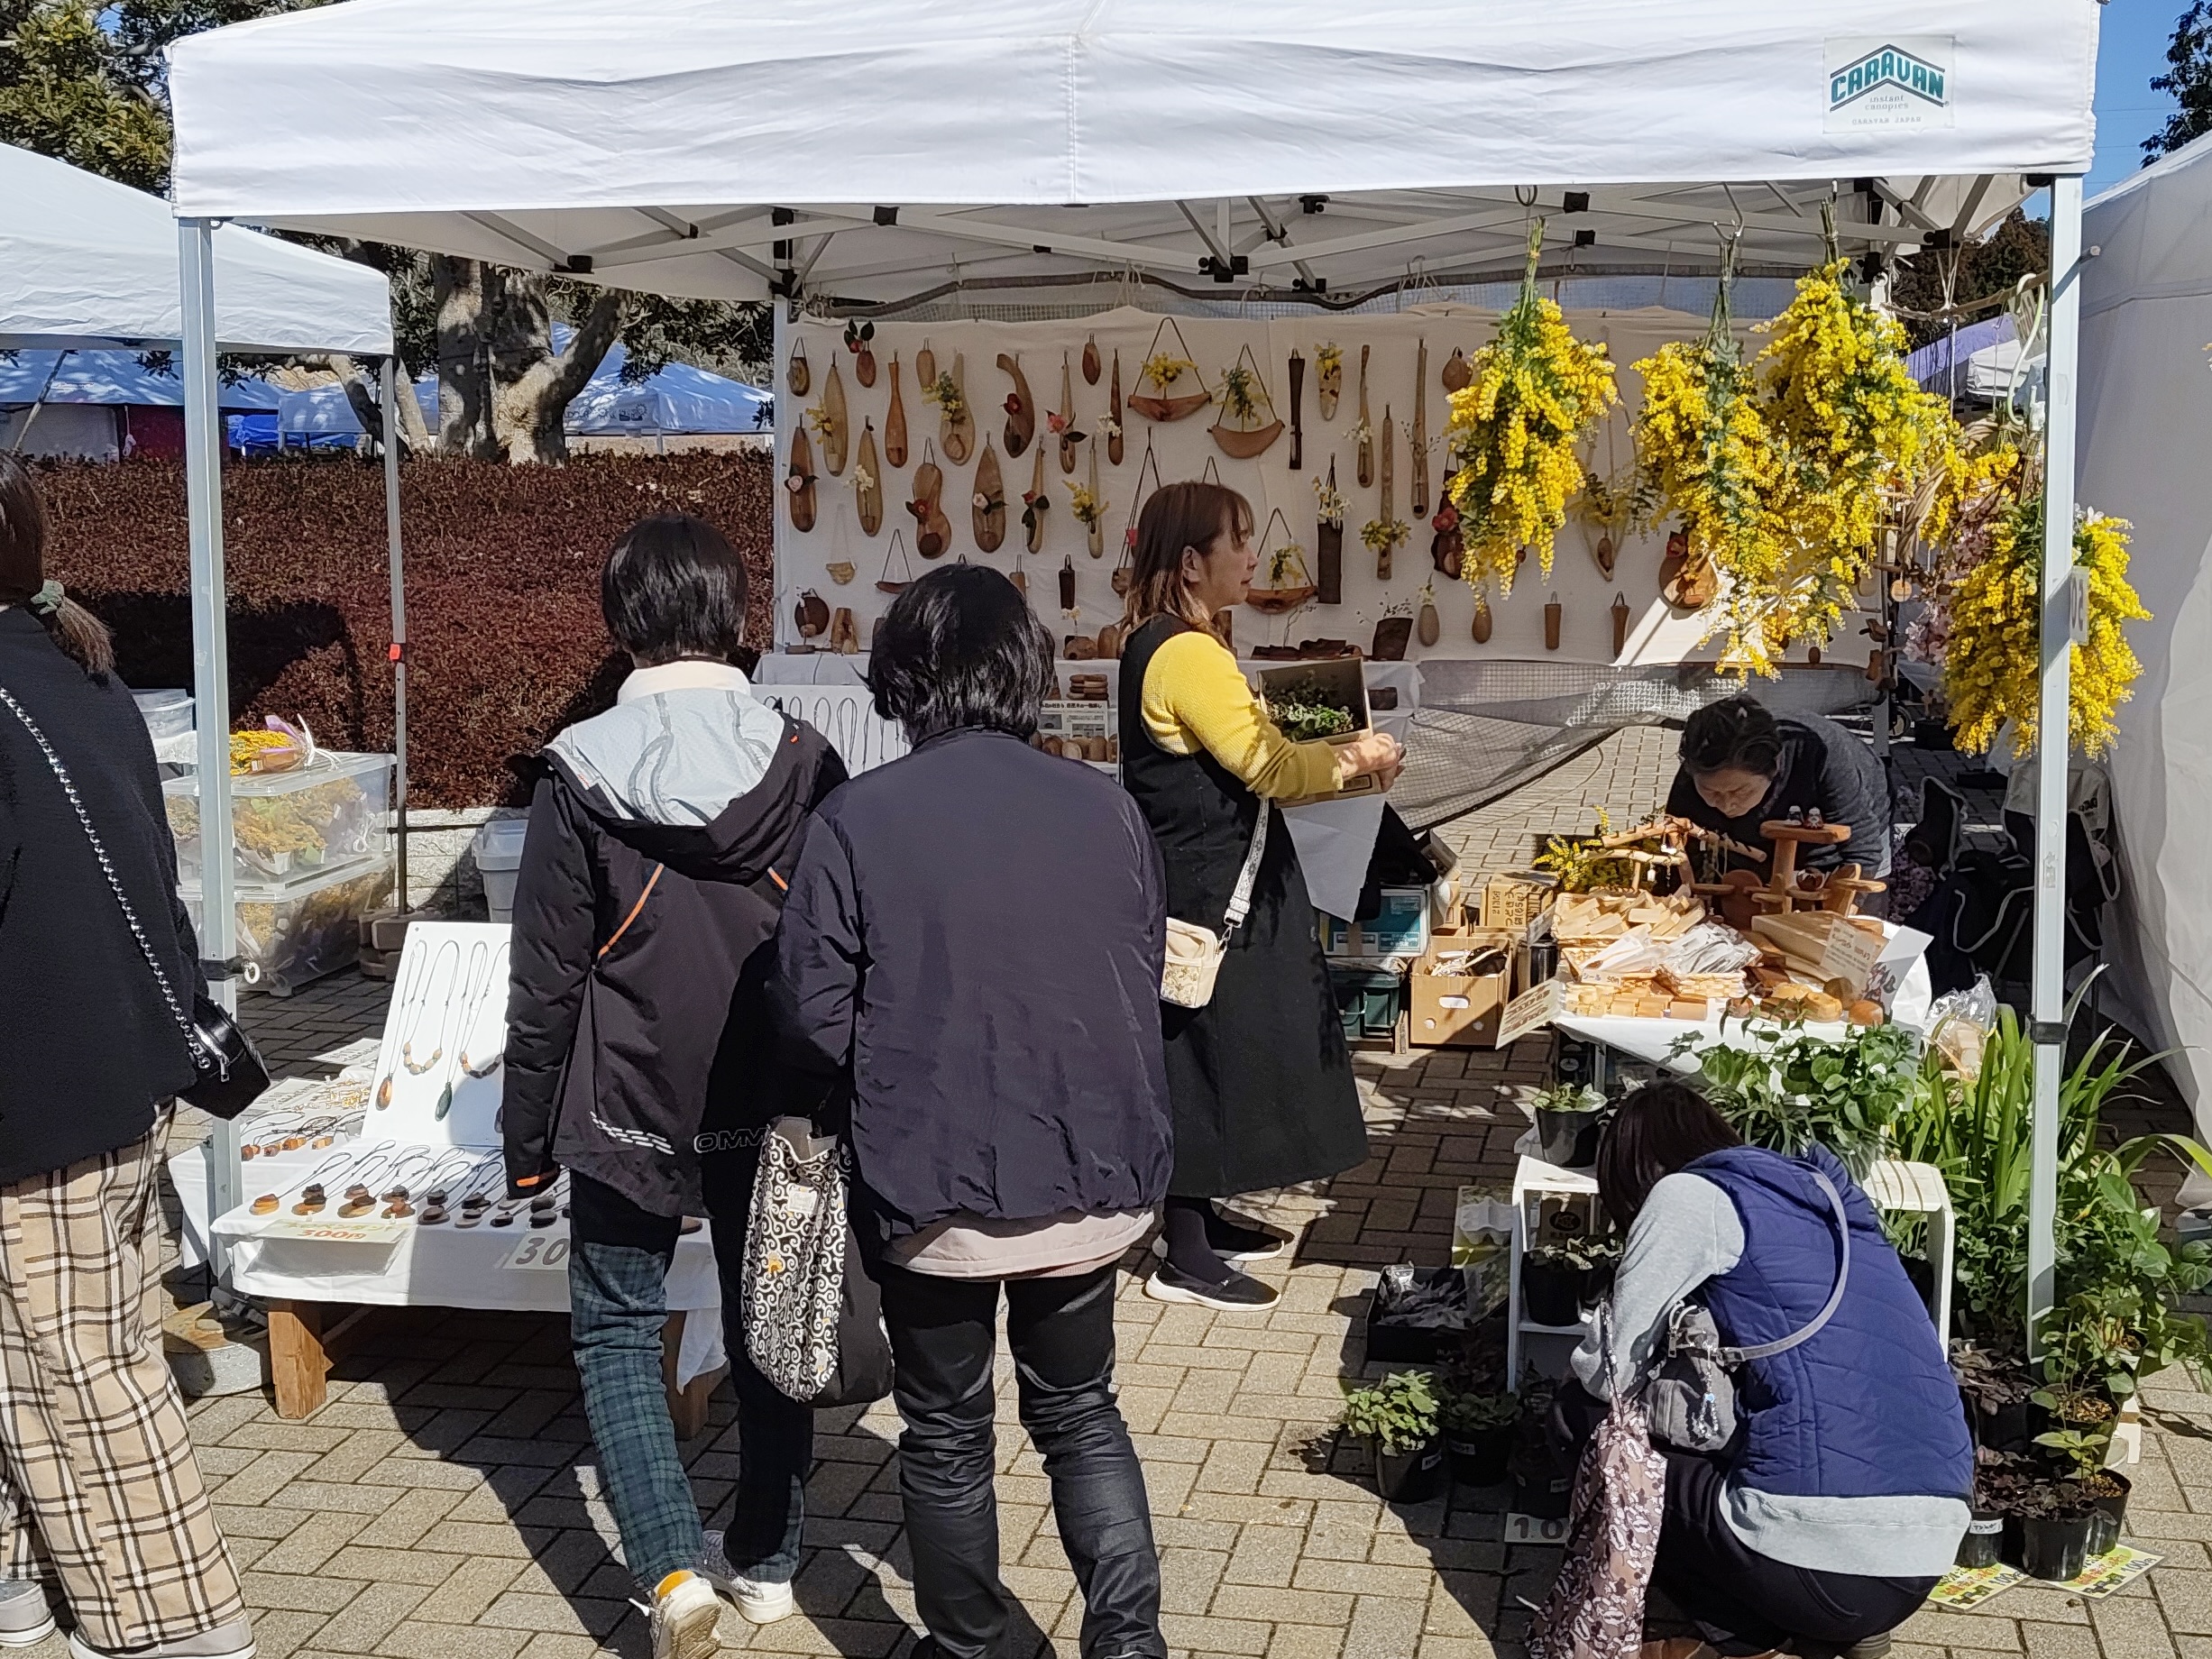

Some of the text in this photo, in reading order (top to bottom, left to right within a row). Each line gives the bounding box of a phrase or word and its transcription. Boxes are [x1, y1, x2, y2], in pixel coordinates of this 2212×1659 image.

[1831, 51, 1944, 103] CARAVAN
[1869, 95, 1905, 103] instant
[1865, 103, 1909, 112] canopies
[1851, 117, 1890, 125] CARAVAN
[515, 1237, 570, 1266] 30
